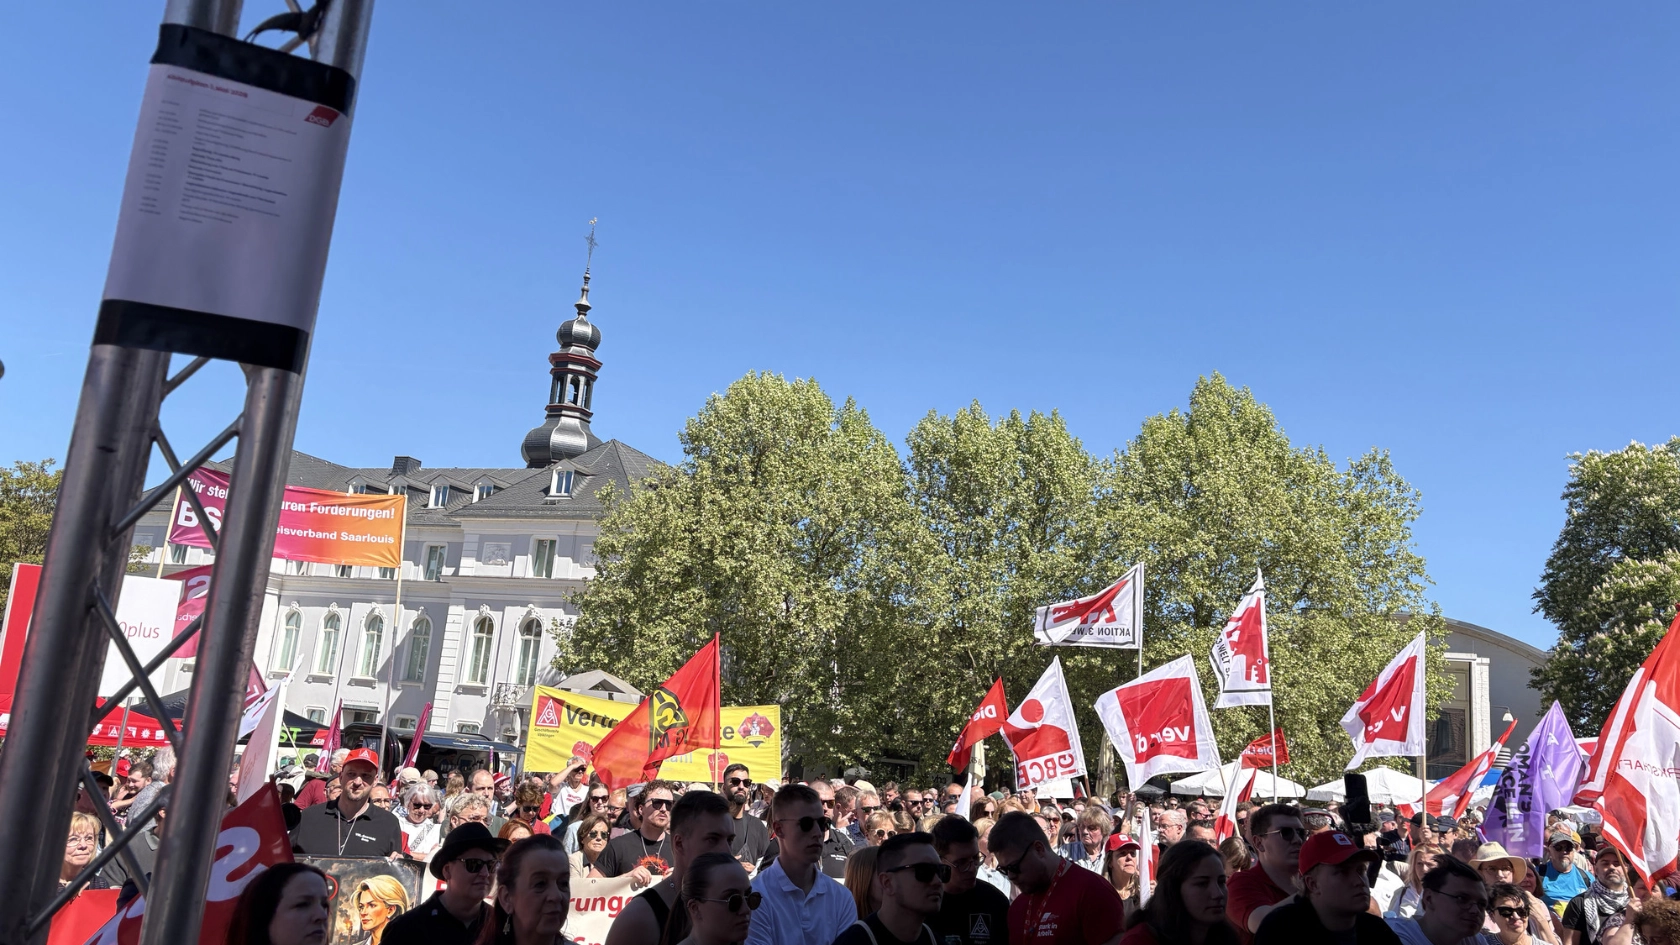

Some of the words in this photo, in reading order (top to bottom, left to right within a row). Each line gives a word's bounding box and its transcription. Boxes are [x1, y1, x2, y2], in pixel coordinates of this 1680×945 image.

[308, 114, 330, 127] DGB
[177, 500, 225, 532] BS
[310, 502, 395, 520] Forderungen!
[340, 531, 395, 544] Saarlouis
